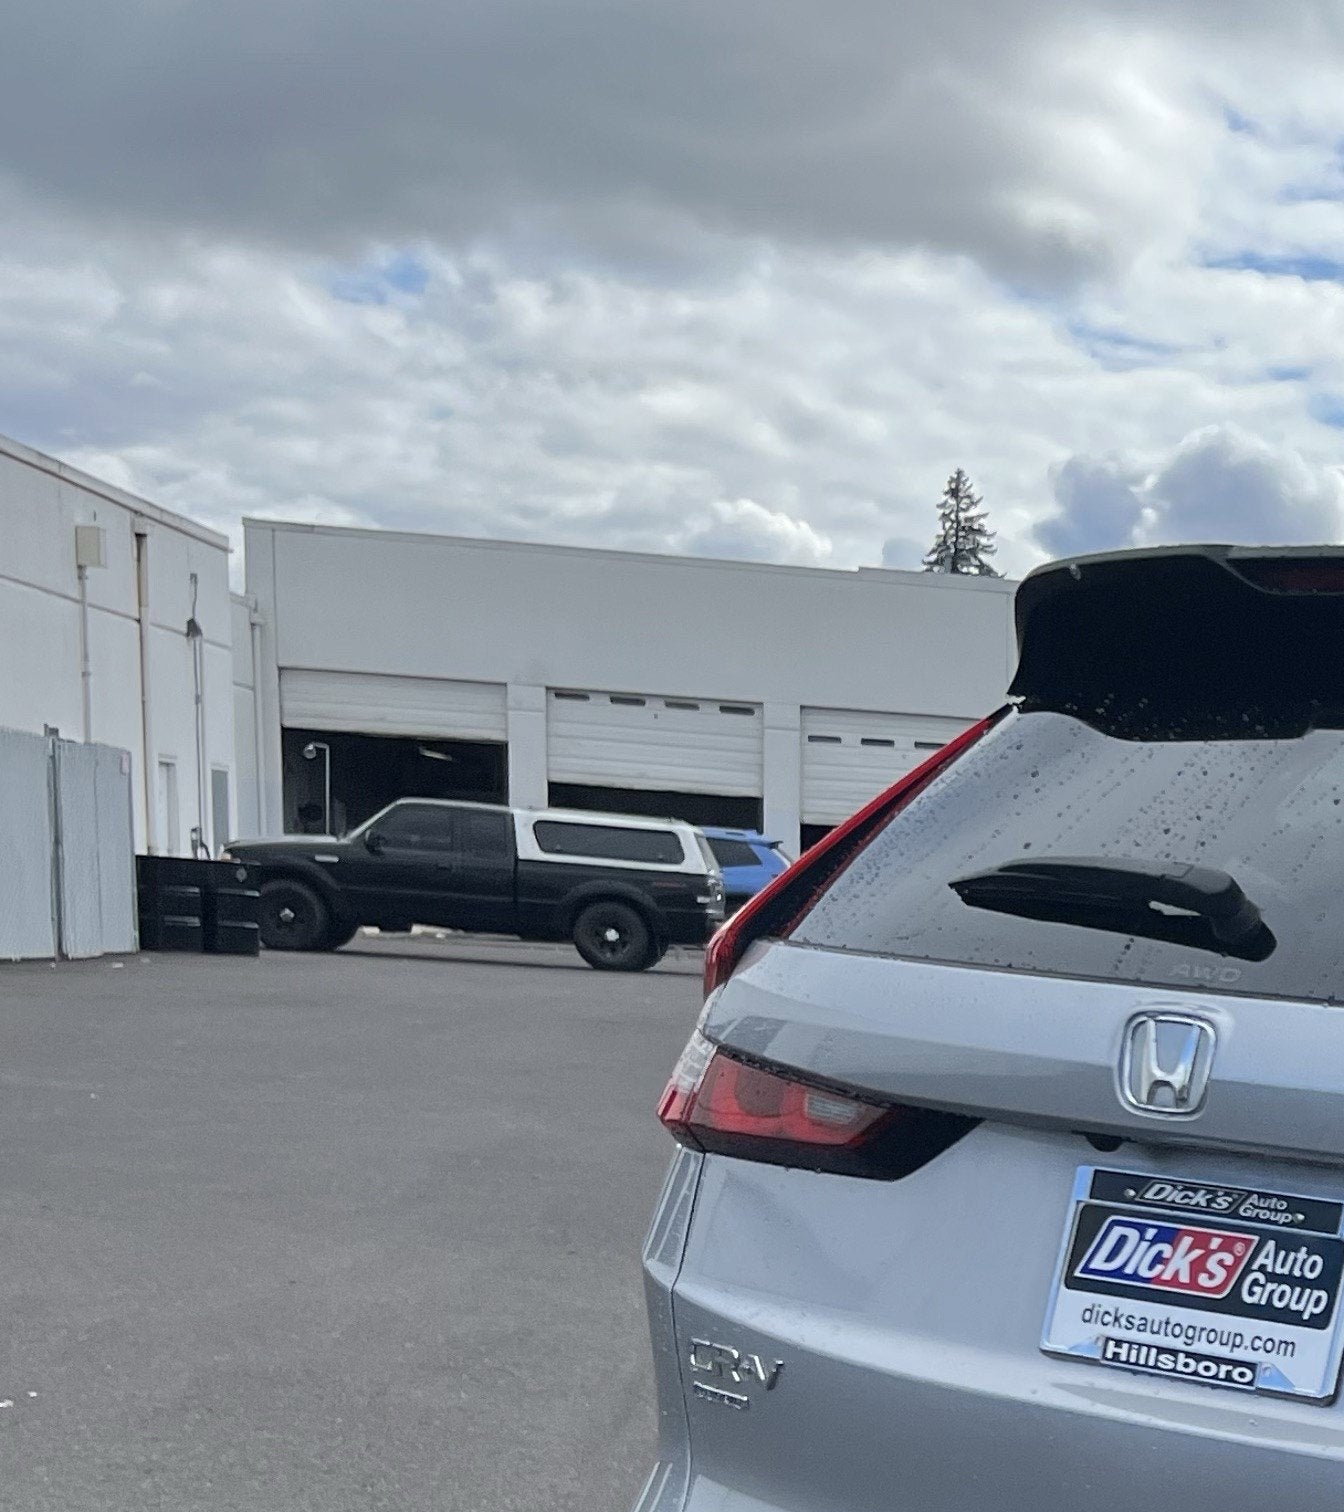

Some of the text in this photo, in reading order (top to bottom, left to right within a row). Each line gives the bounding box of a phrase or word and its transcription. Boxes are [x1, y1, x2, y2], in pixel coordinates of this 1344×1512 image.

[1144, 1183, 1234, 1210] Dick's
[1239, 1205, 1293, 1225] Group
[1249, 1194, 1288, 1210] Auto
[1088, 1225, 1235, 1288] Dick's
[1251, 1239, 1324, 1279] Auto
[1241, 1271, 1329, 1320] Group
[1081, 1303, 1296, 1358] dicksautogroup.com
[1104, 1340, 1254, 1384] Hillsboro
